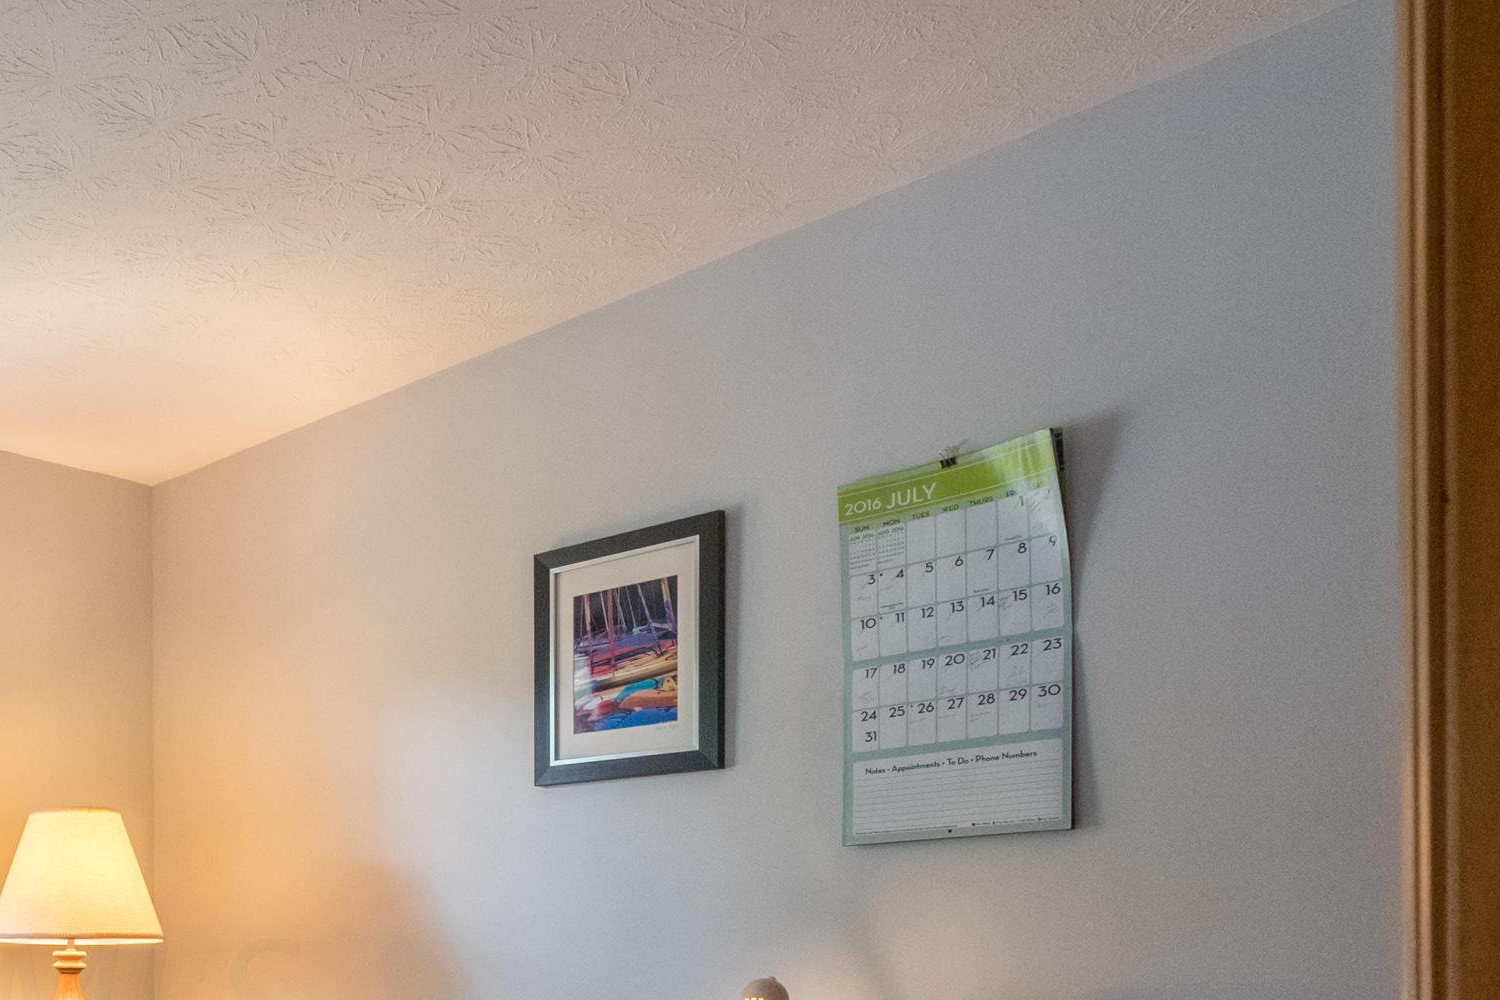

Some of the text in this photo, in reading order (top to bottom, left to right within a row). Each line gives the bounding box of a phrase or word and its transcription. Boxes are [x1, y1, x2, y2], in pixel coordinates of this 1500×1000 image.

[844, 482, 937, 516] 2016 JULY
[854, 525, 869, 533] SUN
[882, 518, 900, 527] MON
[912, 511, 930, 520] TUES
[867, 535, 1057, 585] 3 4 5 6 7 8 9
[861, 583, 1061, 630] 10 11 12 13 14 15 16
[865, 638, 1062, 679] 17 18 19 20 21 22 23
[861, 684, 1061, 721] 24 25 26 27 28 29 30
[865, 731, 877, 742] 31
[865, 750, 1038, 775] Notes Appointments To Do Phone Numbers
